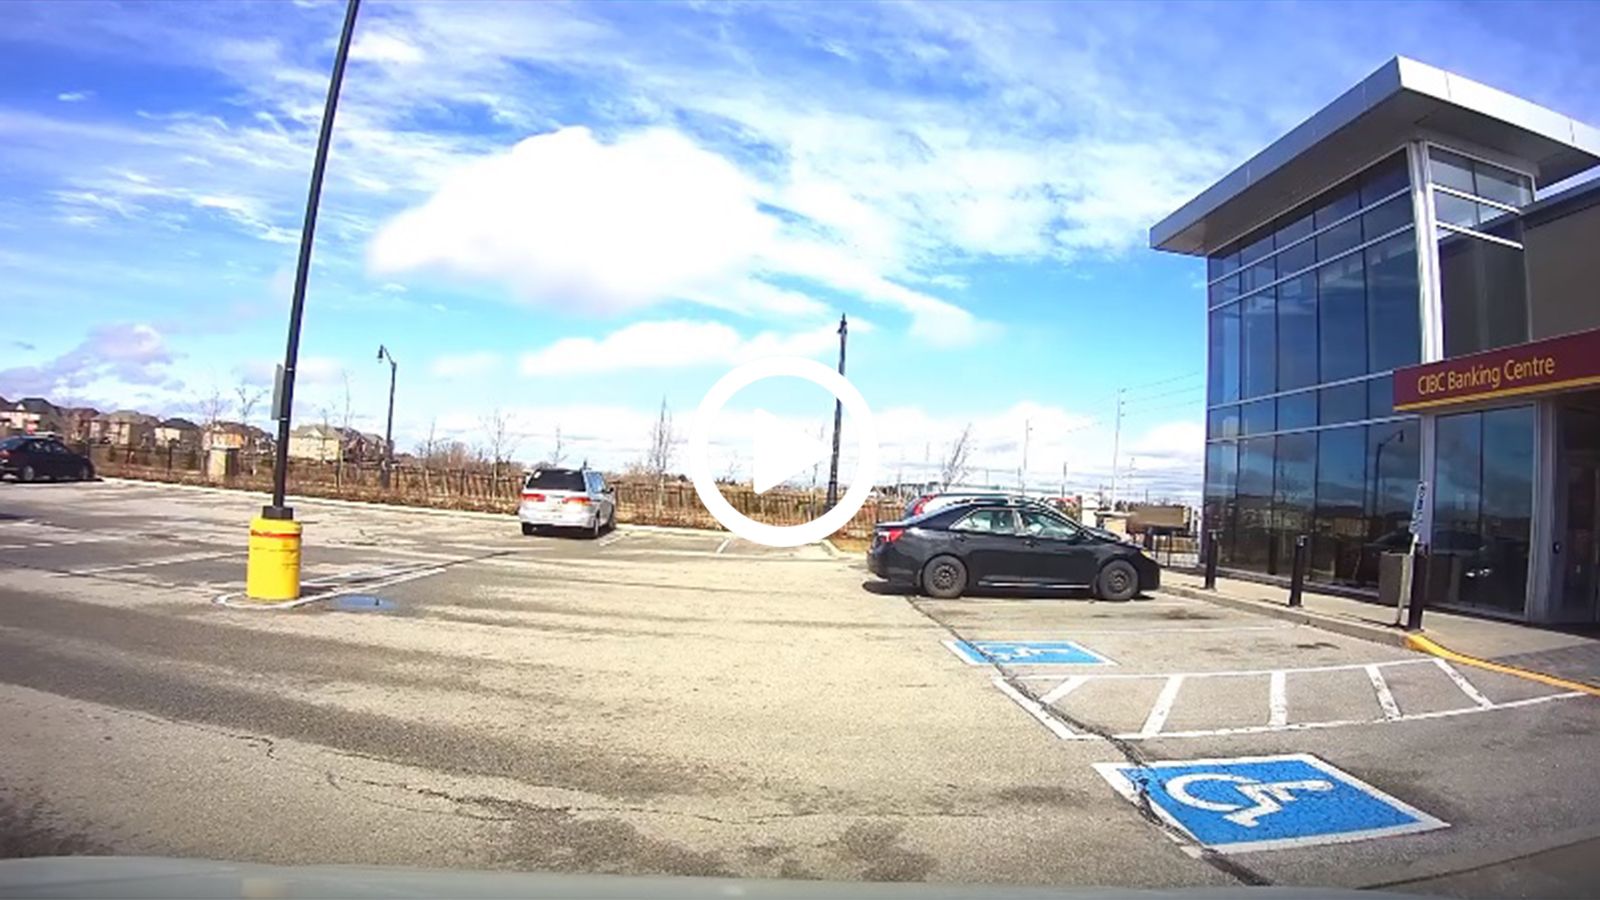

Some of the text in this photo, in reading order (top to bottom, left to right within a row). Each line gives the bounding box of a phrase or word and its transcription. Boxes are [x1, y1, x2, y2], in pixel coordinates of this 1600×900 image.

[1417, 357, 1556, 395] CIBC Banking Centre
